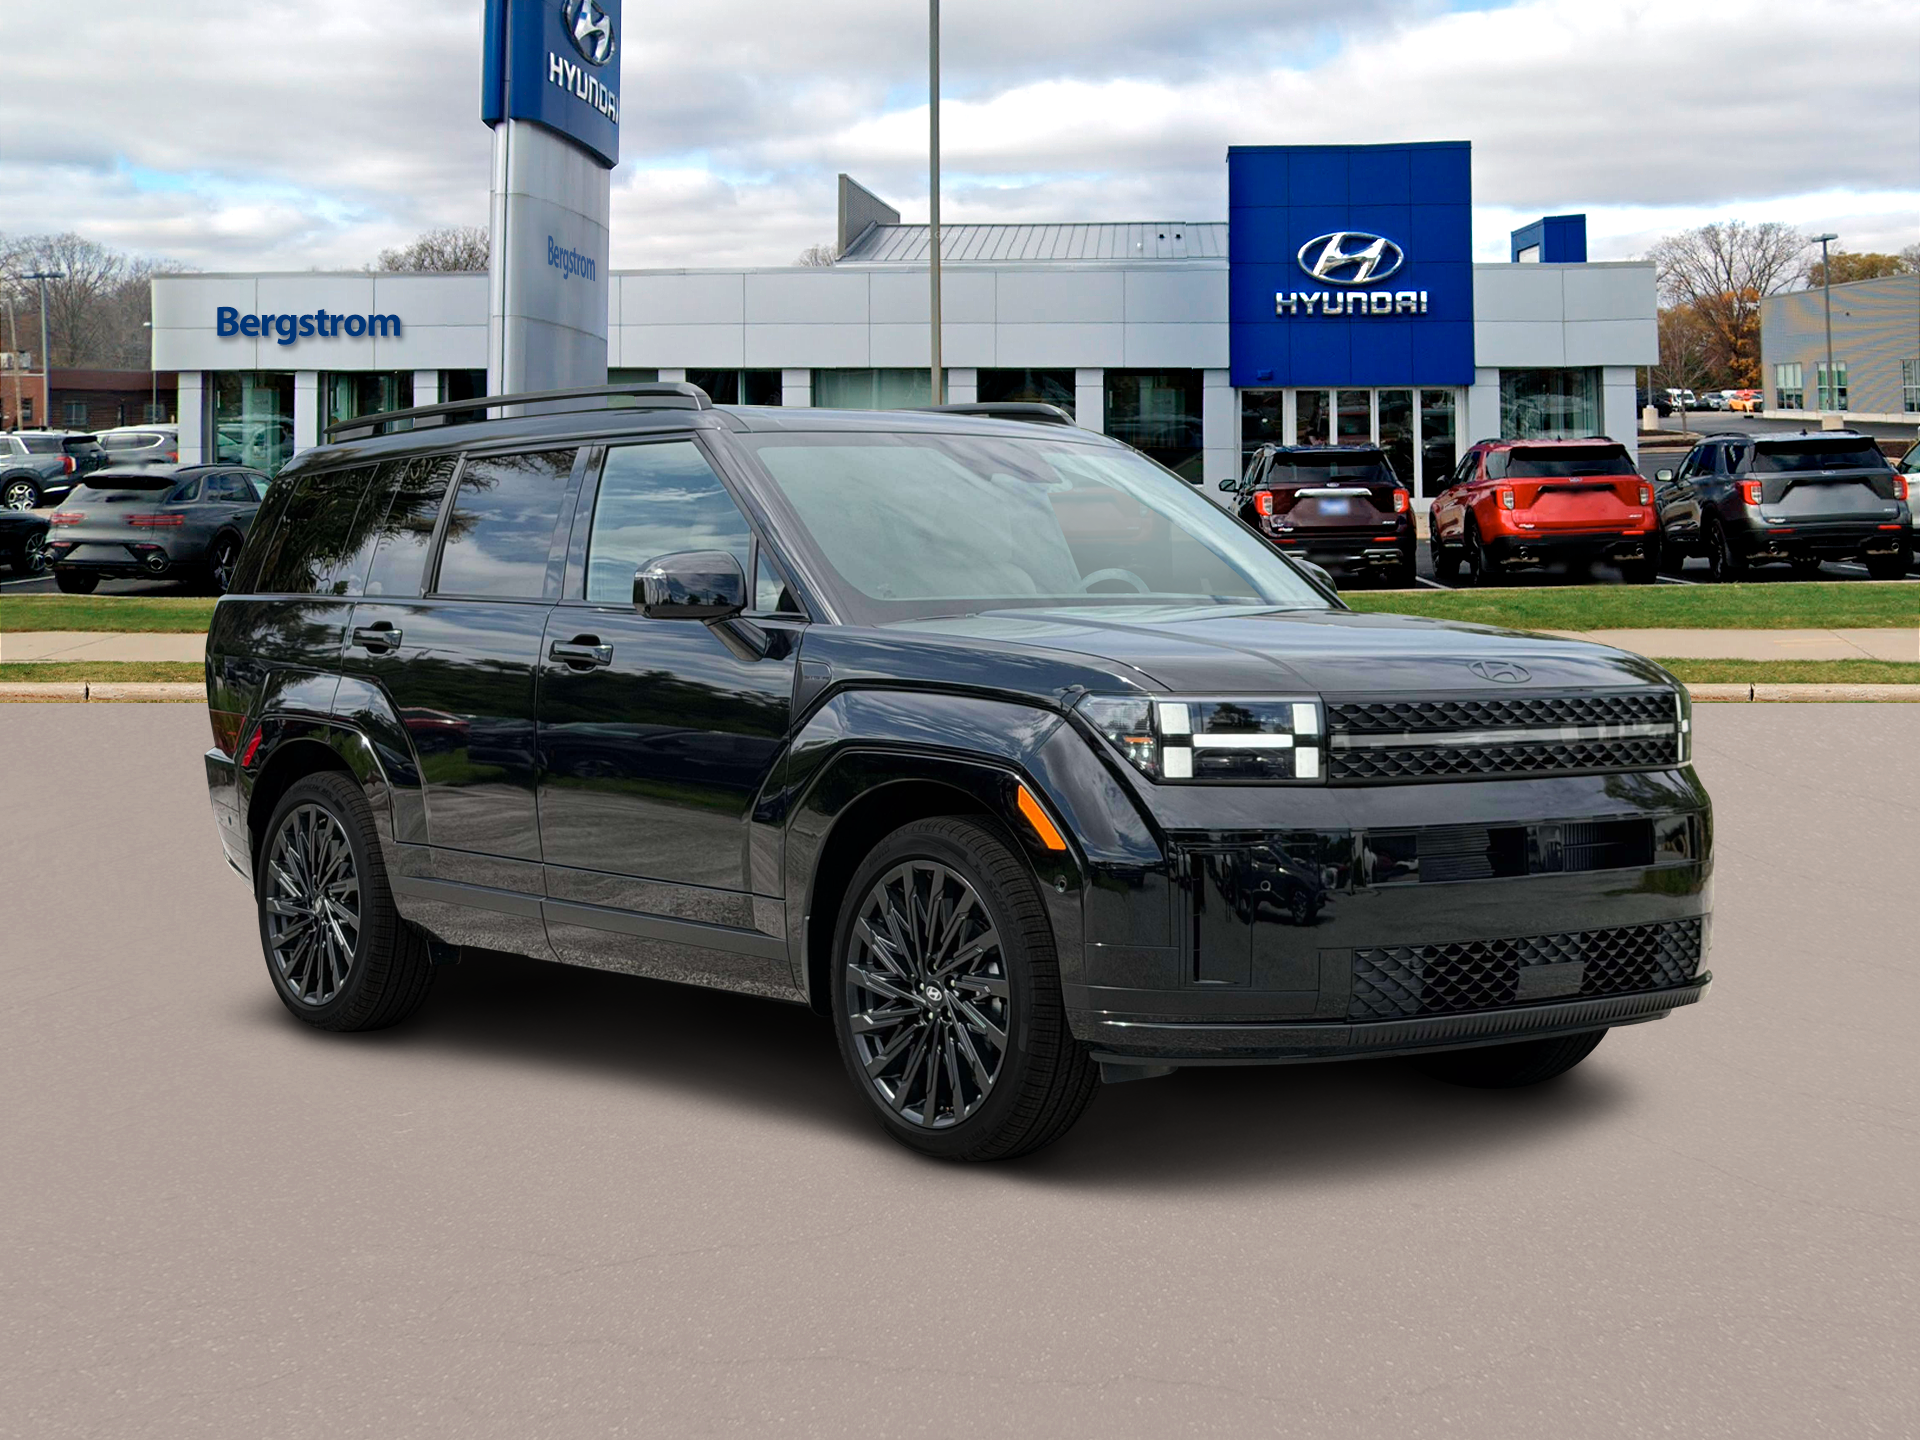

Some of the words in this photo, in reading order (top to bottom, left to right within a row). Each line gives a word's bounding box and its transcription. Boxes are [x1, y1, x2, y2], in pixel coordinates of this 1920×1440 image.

[549, 52, 619, 124] HYUNDAI
[547, 235, 596, 282] Bergstrom
[1275, 290, 1428, 315] HYUNDAI
[216, 306, 401, 346] Bergstrom
